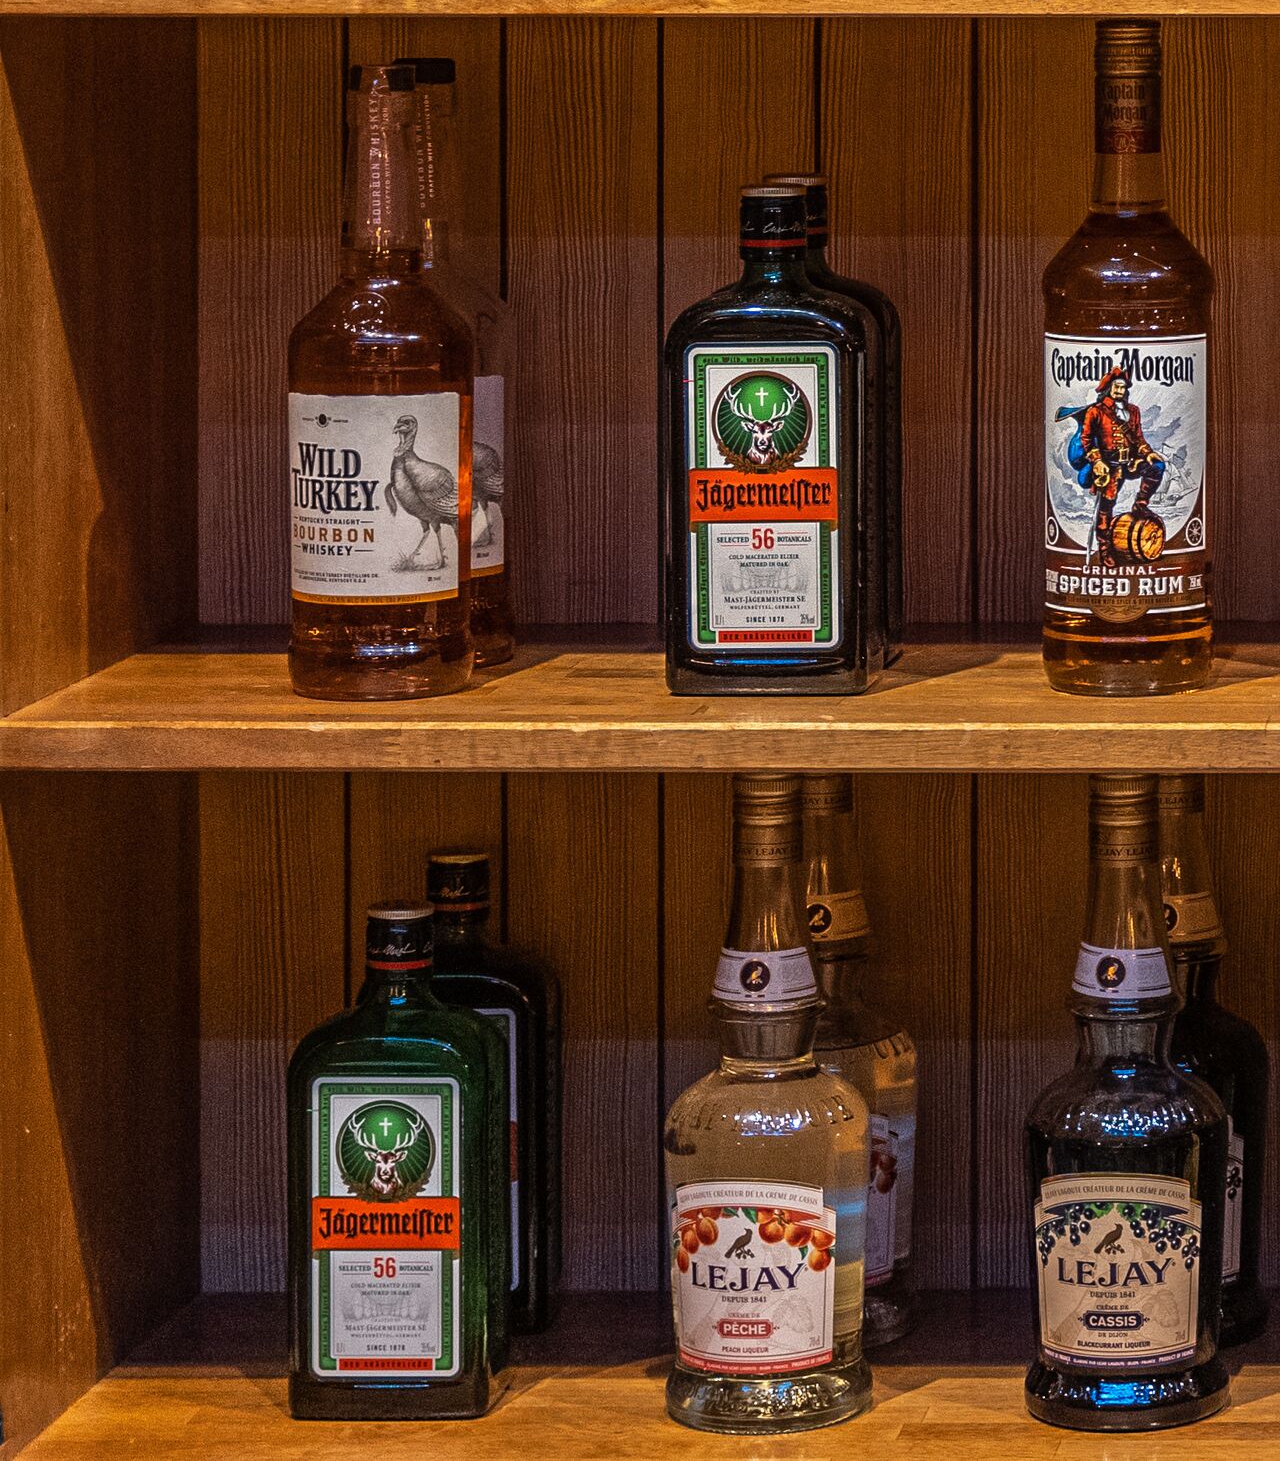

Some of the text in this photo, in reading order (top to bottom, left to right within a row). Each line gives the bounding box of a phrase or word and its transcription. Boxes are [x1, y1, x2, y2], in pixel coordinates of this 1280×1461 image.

[1051, 347, 1195, 388] Captain Morgan
[298, 442, 362, 479] WILD
[292, 468, 376, 514] TURKEY
[293, 524, 375, 543] BOURBON
[752, 528, 774, 550] 56
[301, 544, 353, 556] WHISKEY
[1059, 575, 1184, 597] SPICED RUM
[373, 1257, 396, 1279] 56
[691, 1261, 804, 1292] LEJAY
[1057, 1257, 1171, 1288] LEJAY
[723, 1321, 767, 1335] PÊCHE
[1089, 1315, 1137, 1327] CASSIS
